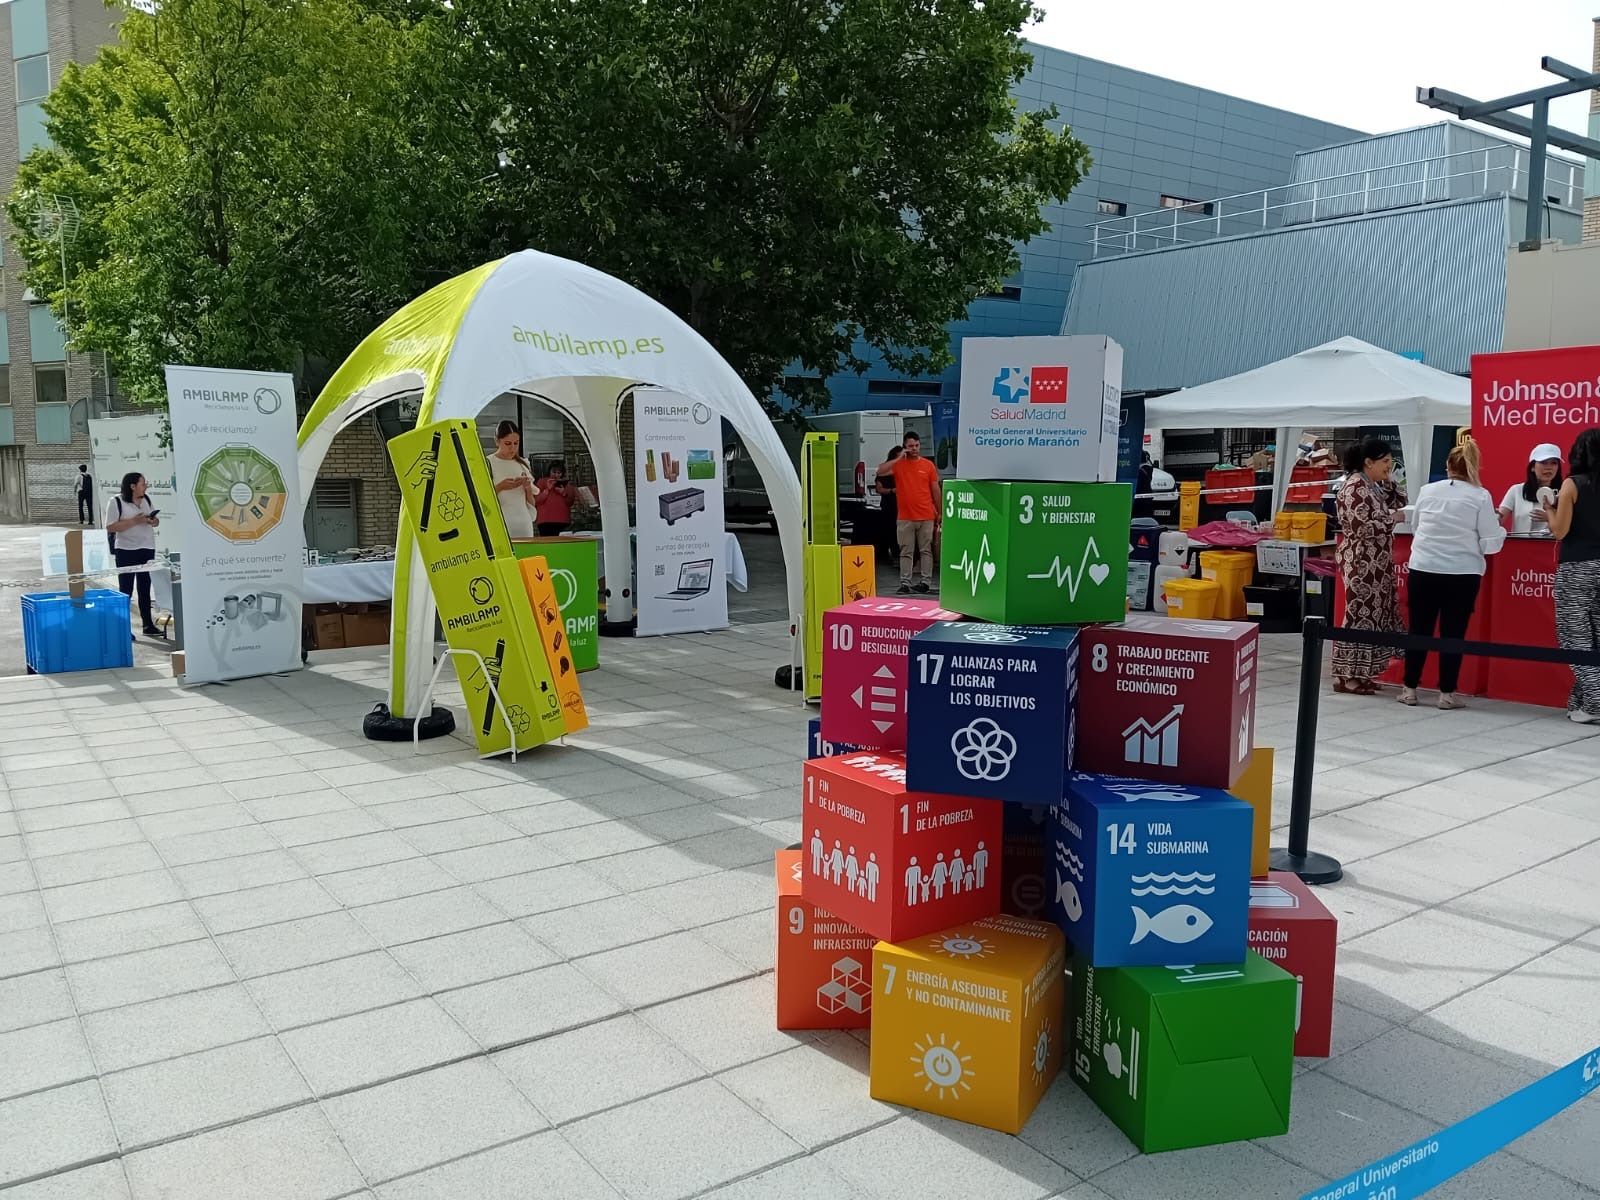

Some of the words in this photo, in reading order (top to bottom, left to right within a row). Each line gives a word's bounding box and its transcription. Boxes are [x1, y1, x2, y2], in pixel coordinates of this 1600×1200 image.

[512, 325, 665, 360] ambilamp.es
[183, 389, 248, 402] AMBILAMP
[644, 406, 689, 416] AMBILAMP
[990, 408, 1066, 420] SaludMadrid
[1483, 401, 1599, 427] MedTech
[187, 424, 209, 434] ¿Qué
[210, 425, 257, 434] reciclamos?
[968, 427, 1000, 437] Hospital
[1036, 428, 1087, 436] Universitario
[975, 436, 1024, 448] Gregorio
[1028, 436, 1080, 447] Marañón
[946, 491, 954, 518] 3
[958, 492, 974, 504] SALUD
[1042, 496, 1071, 507] SALUD
[957, 508, 961, 519] Y
[962, 509, 988, 521] BIENESTAR
[1019, 495, 1034, 524] 3
[1042, 512, 1049, 524] Y
[1050, 512, 1096, 524] BIENESTAR
[202, 557, 217, 567] ¿En
[218, 556, 234, 566] qué
[246, 553, 286, 563] convierte?
[431, 549, 481, 573] ambilamp.es
[1511, 568, 1555, 583] Johns
[1511, 584, 1557, 598] MedTe
[447, 605, 500, 630] AMBILAMP
[829, 623, 854, 652] 10
[861, 626, 911, 640] REDUCCIÓN
[861, 642, 909, 656] DESIGUALD
[1117, 645, 1162, 660] TRABAJO
[1165, 648, 1210, 664] DECENTE
[951, 656, 1004, 671] ALIANZAS
[1007, 658, 1038, 673] PARA
[1091, 643, 1108, 673] 8
[917, 653, 944, 685] 17
[1116, 663, 1124, 675] Y
[1126, 663, 1195, 680] CRECIMIENTO
[950, 674, 995, 689] LOGRAR
[1116, 679, 1177, 696] ECONÓMICO
[950, 692, 971, 705] LOS
[975, 693, 1036, 710] OBJETIVOS
[807, 776, 814, 804] 1
[819, 779, 829, 793] FIN
[819, 796, 828, 810] DE
[828, 799, 836, 812] LA
[837, 803, 866, 825] POBREZA
[916, 801, 929, 813] FIN
[900, 804, 909, 834] 1
[916, 818, 926, 832] DE
[928, 817, 938, 829] LA
[939, 809, 974, 827] POBREZA
[1147, 823, 1172, 836] VIDA
[1106, 823, 1137, 855] 14
[1147, 840, 1208, 855] SUBMARINA
[789, 907, 804, 935] 9
[972, 920, 1049, 939] CONTAMINANTE
[1247, 927, 1288, 942] CACIÓN
[814, 938, 879, 951] INFRAESTRUC
[881, 963, 897, 995] 7
[906, 968, 949, 991] ENERGÍA
[951, 978, 1008, 1004] ASEQUIBLE
[906, 987, 913, 1001] Y
[915, 990, 929, 1004] NO
[932, 993, 1012, 1023] CONTAMINANTE
[1084, 965, 1095, 1034] ECOSISTEMAS
[1092, 994, 1102, 1056] TERRESTRES
[1084, 1036, 1092, 1049] DE
[1074, 1048, 1091, 1083] 15
[1362, 1140, 1439, 1187] Universitario
